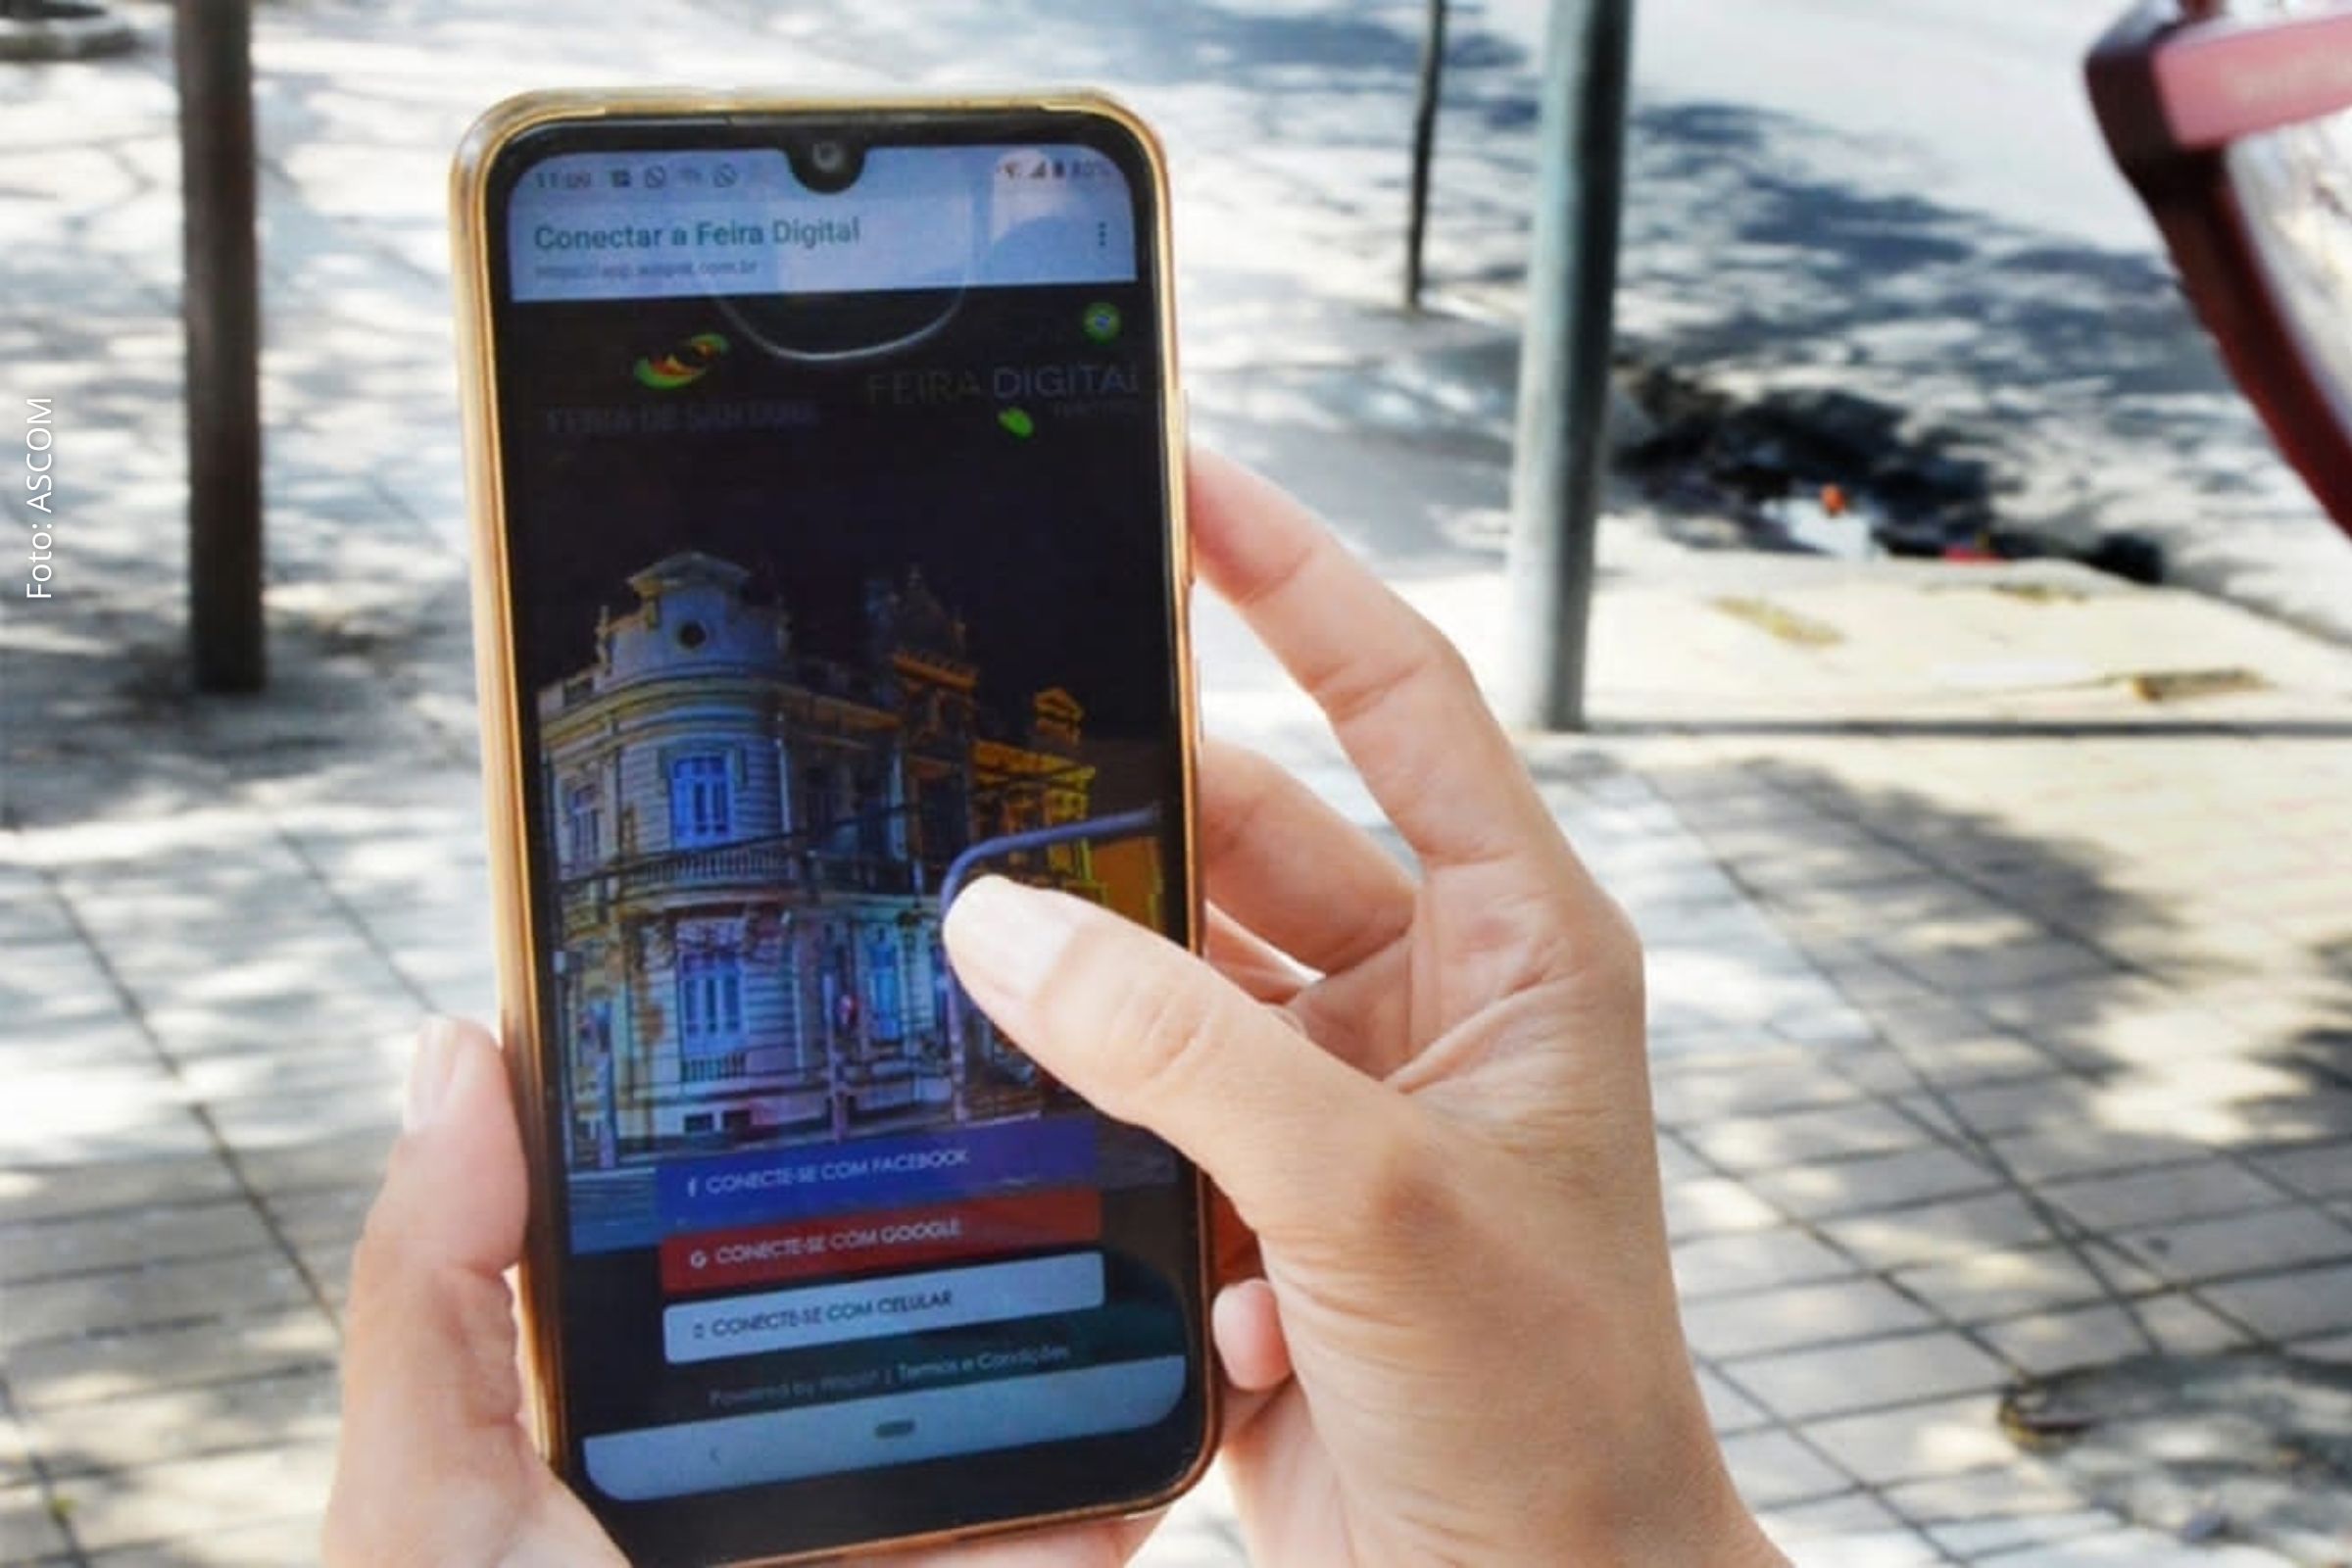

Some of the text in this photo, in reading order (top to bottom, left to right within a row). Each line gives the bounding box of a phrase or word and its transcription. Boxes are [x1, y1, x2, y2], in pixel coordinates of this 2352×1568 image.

[534, 216, 860, 249] Conectar a Feira Digital
[867, 369, 980, 405] FEIRA
[705, 1165, 816, 1196] CONECTE-SE
[821, 1159, 869, 1181] COM
[873, 1149, 970, 1174] FACEBOOK
[716, 1235, 826, 1264] CONECTE-SE
[832, 1230, 878, 1250] COM
[881, 1218, 961, 1244] GOOGLE
[710, 1289, 954, 1337] CONECTE-SE COM CELULAR
